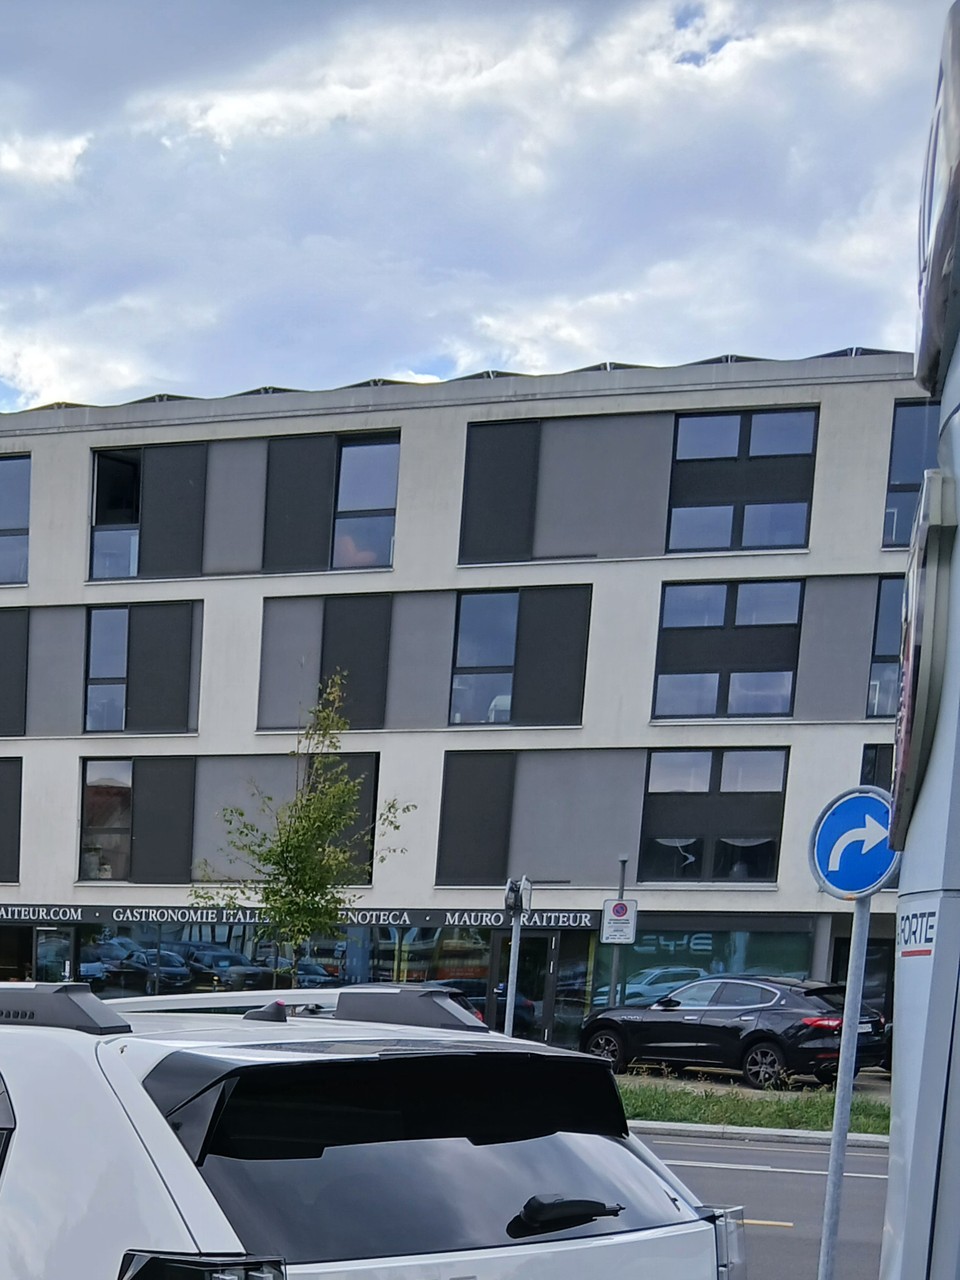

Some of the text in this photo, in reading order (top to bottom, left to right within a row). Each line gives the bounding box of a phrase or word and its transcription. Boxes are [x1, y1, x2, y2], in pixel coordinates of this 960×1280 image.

[112, 907, 218, 923] GASTRONOMIE
[444, 912, 592, 928] MAURO RAITEUR
